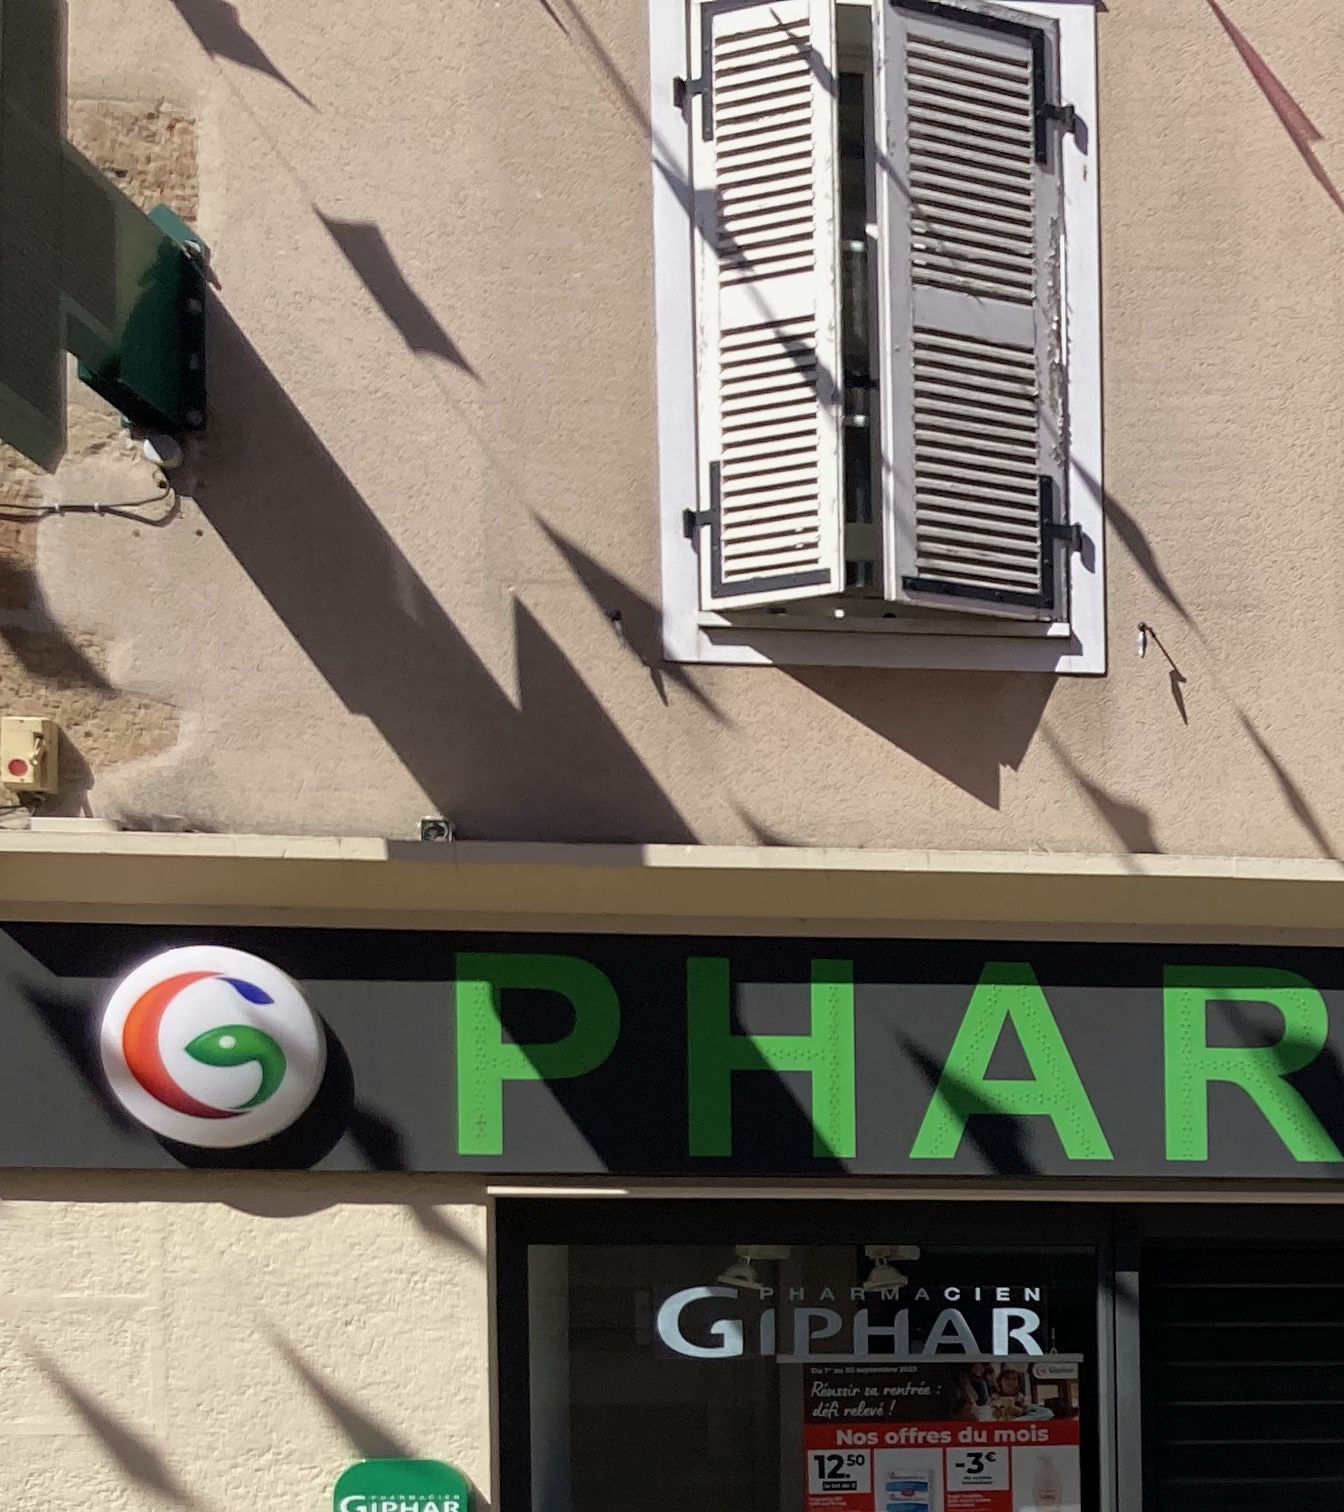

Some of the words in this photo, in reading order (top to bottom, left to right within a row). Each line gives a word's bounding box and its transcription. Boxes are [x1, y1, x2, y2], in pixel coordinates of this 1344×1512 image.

[759, 1286, 1041, 1301] PHARMACIEN
[656, 1286, 1044, 1358] GIPHAR
[810, 1381, 860, 1397] Réussir
[864, 1387, 881, 1397] sa
[883, 1381, 931, 1397] rentrée
[812, 1401, 840, 1419] défi
[843, 1400, 885, 1417] relevé
[836, 1429, 880, 1446] Nos
[884, 1427, 952, 1444] offres
[957, 1426, 989, 1443] du
[994, 1424, 1050, 1442] mois
